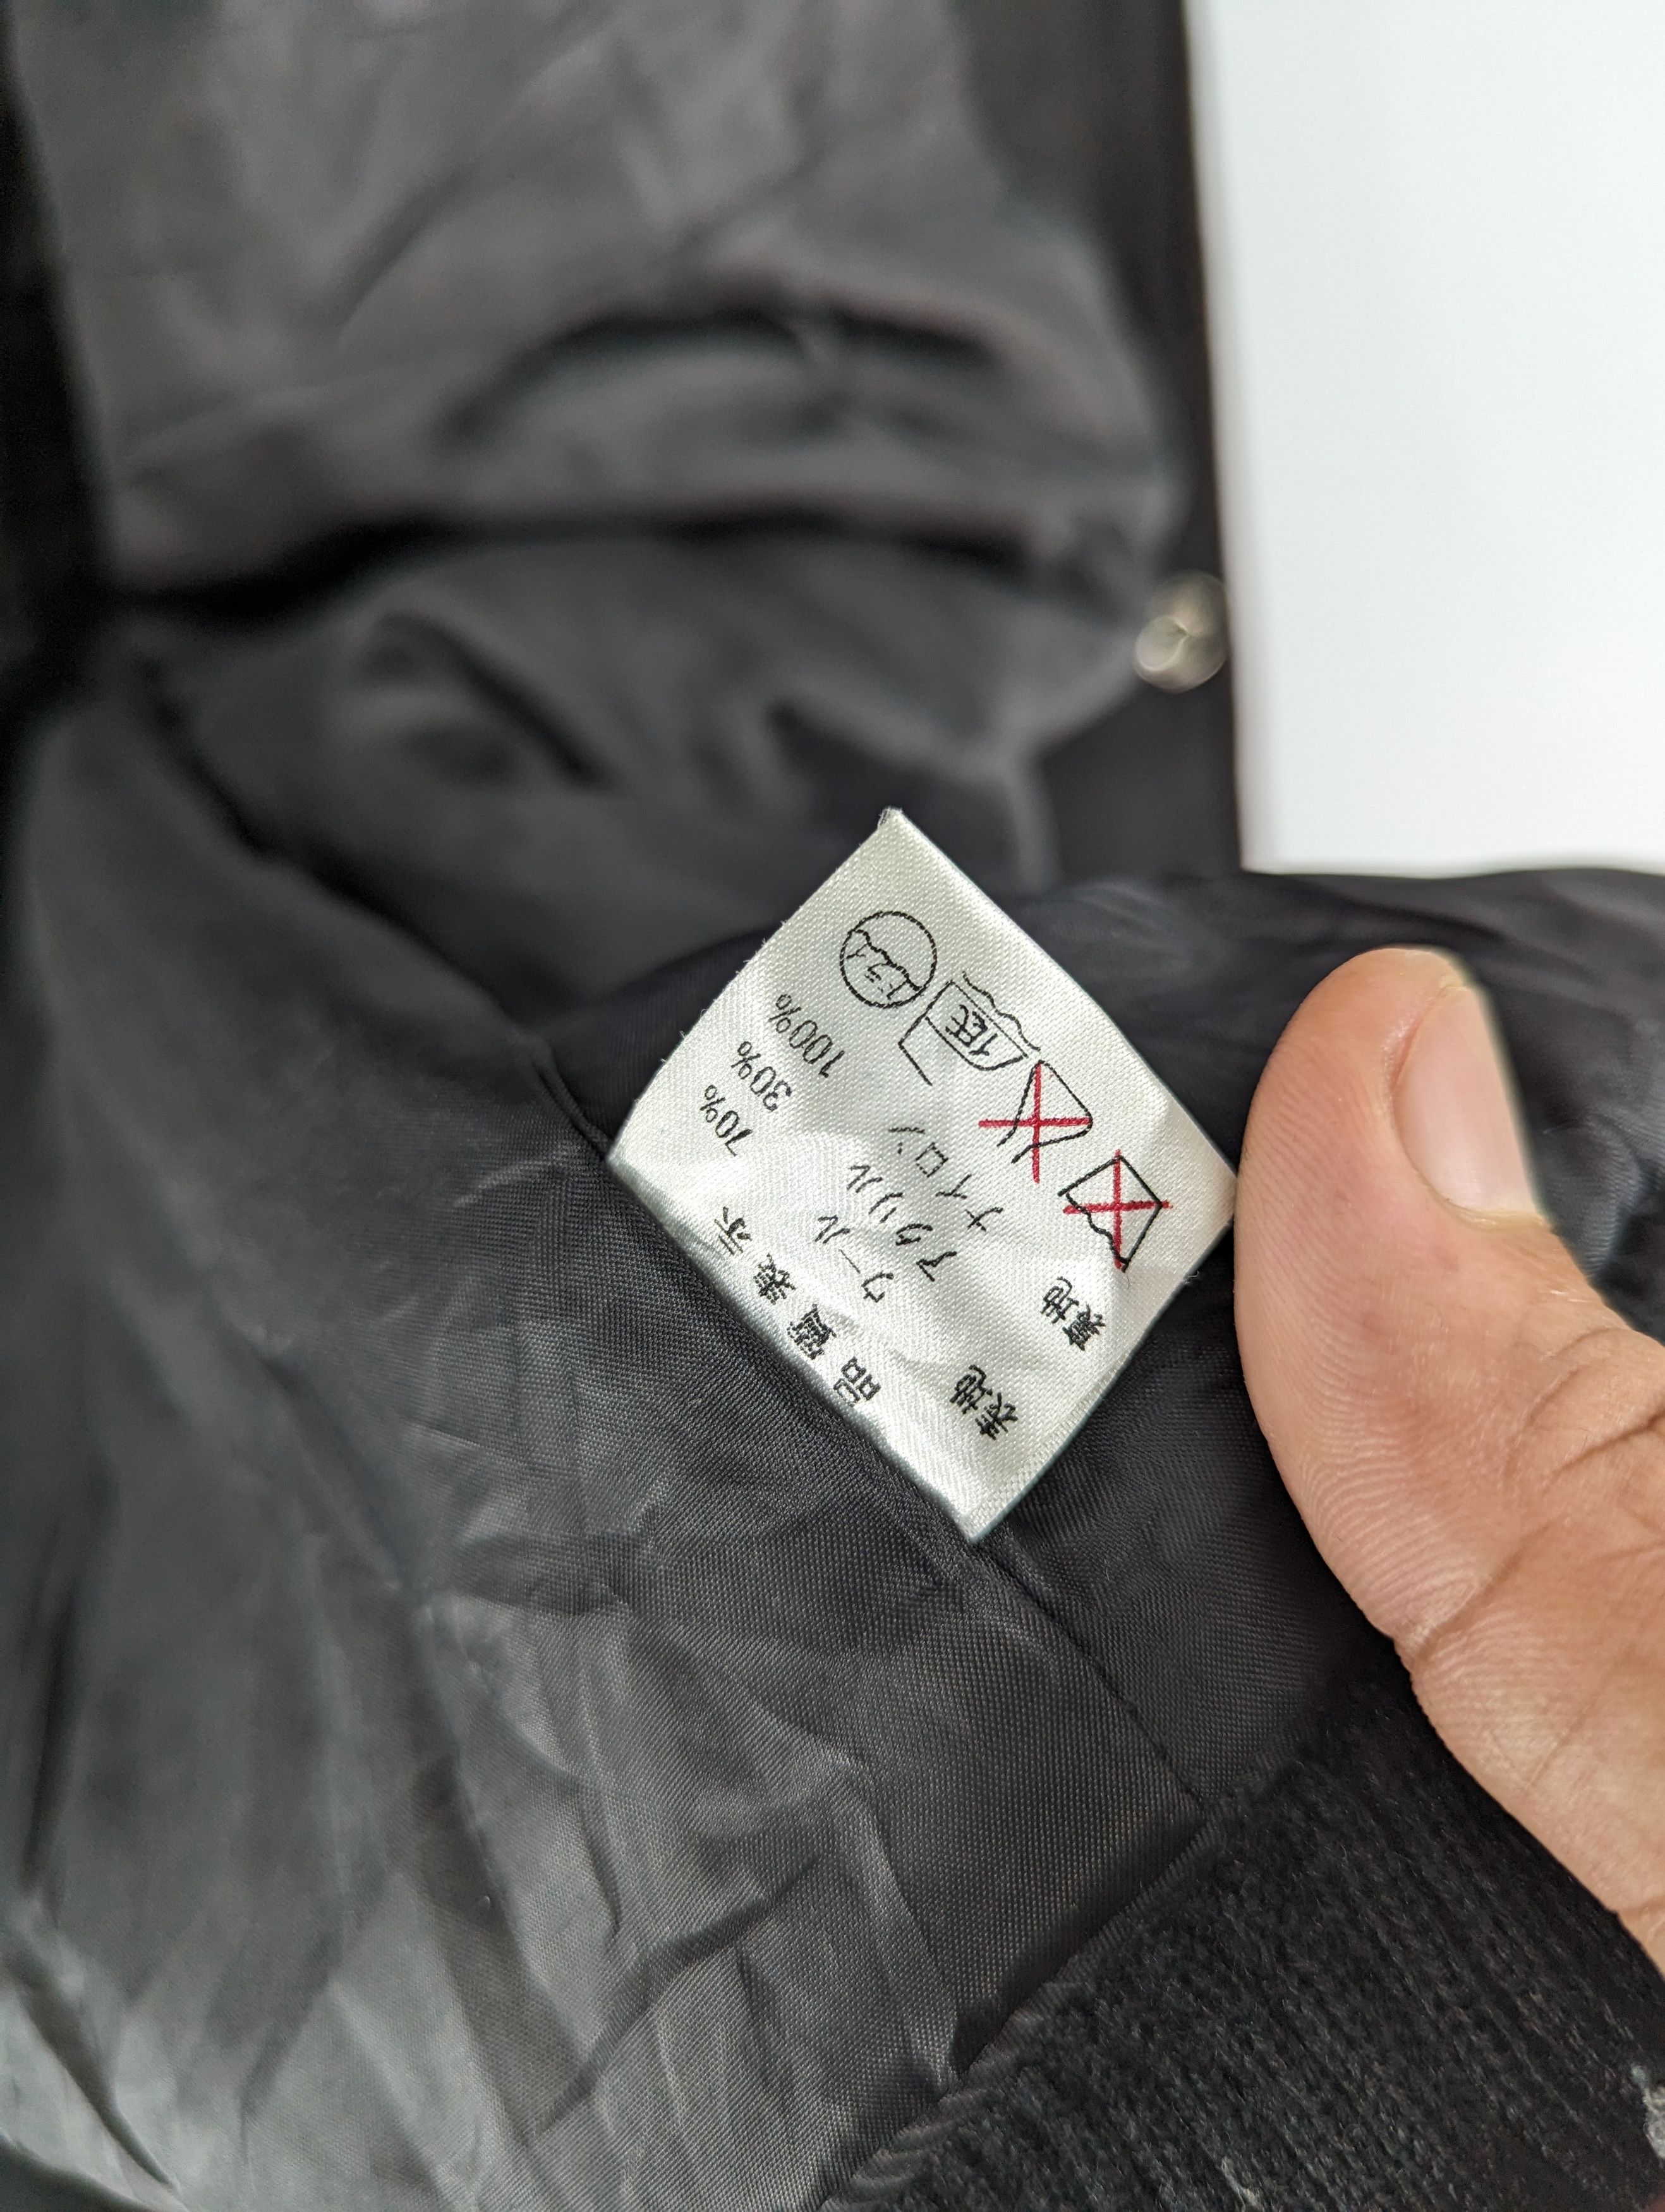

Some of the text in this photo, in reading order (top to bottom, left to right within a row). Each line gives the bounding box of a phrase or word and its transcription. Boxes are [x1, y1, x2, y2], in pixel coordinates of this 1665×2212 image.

[845, 942, 998, 1057] 低 ドライ
[699, 1083, 1019, 1440] 表地 ウール 70%
[730, 1040, 958, 1282] アクリル 30%
[767, 994, 1107, 1352] 裏地 ナイロン 100%
[714, 1206, 881, 1406] 品質表示
